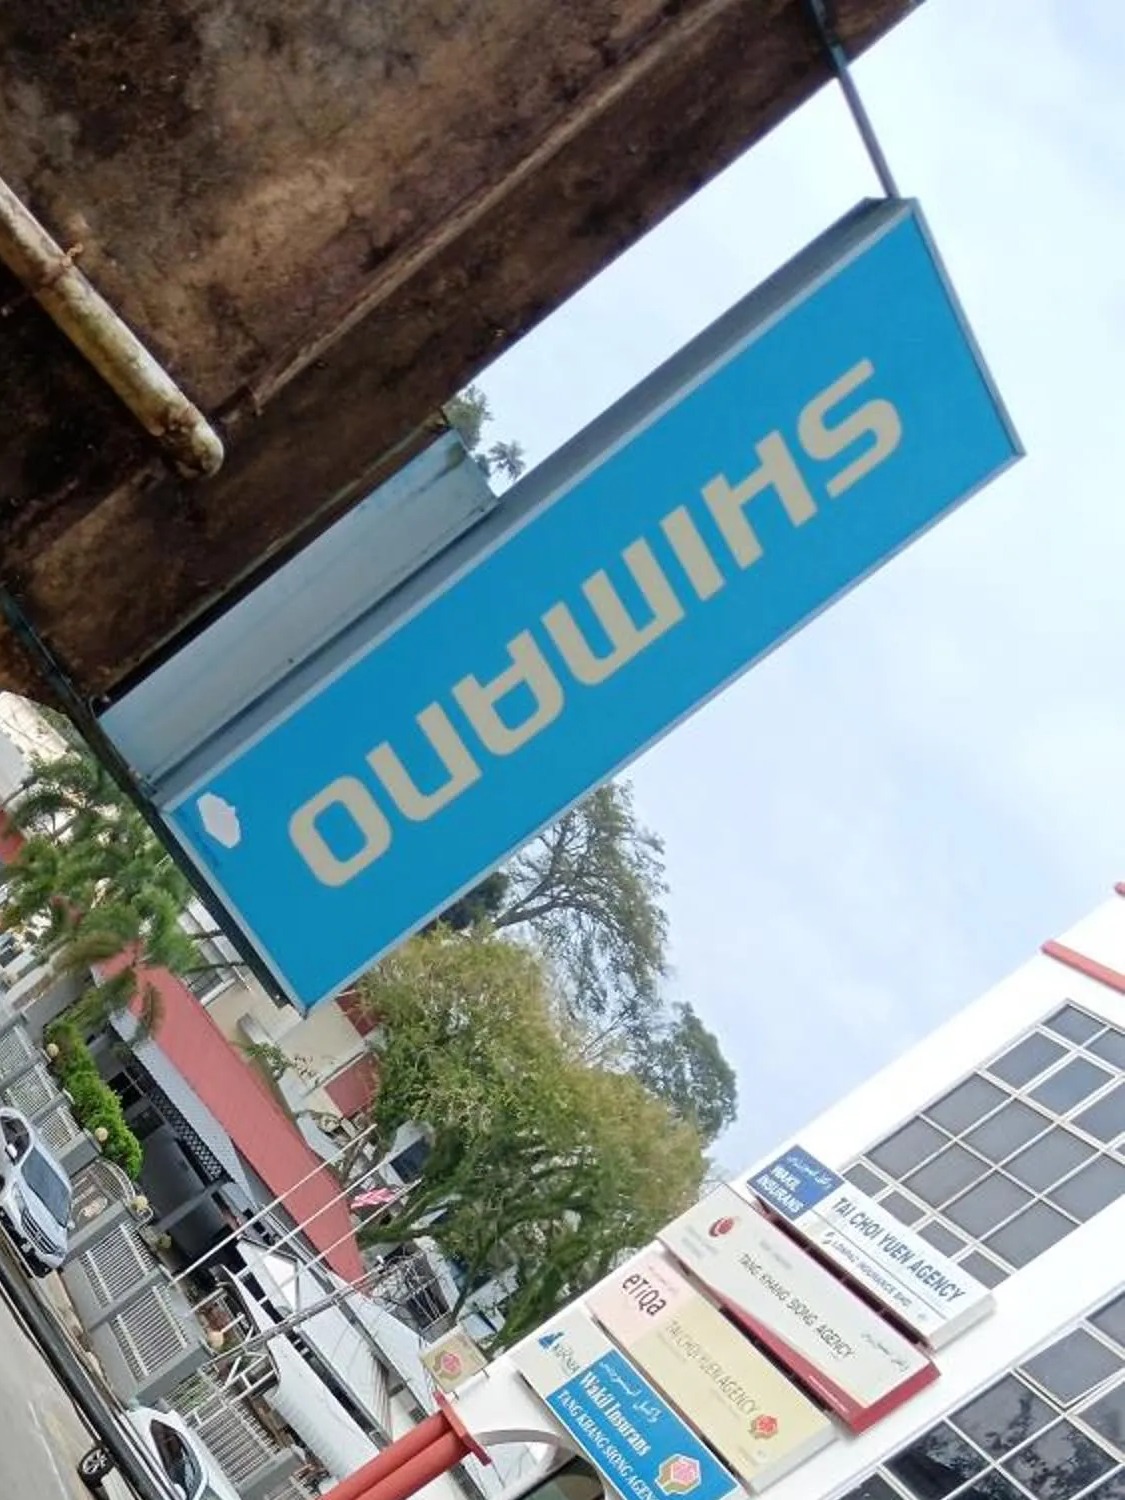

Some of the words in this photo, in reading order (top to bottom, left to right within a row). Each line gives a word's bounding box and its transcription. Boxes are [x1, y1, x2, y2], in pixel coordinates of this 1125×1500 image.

[287, 357, 903, 888] SHIMANO
[830, 1196, 856, 1218] TAI
[847, 1210, 884, 1241] CHOI
[877, 1232, 915, 1266] YUEN
[905, 1257, 965, 1304] AGENCY
[813, 1322, 855, 1358] AGENCY
[555, 1389, 583, 1417] TANG
[574, 1411, 611, 1449] KHANG
[600, 1442, 634, 1478] SIONG
[576, 1370, 615, 1410] Wakil
[601, 1401, 655, 1458] Insurans
[713, 1371, 761, 1418] AGENCY
